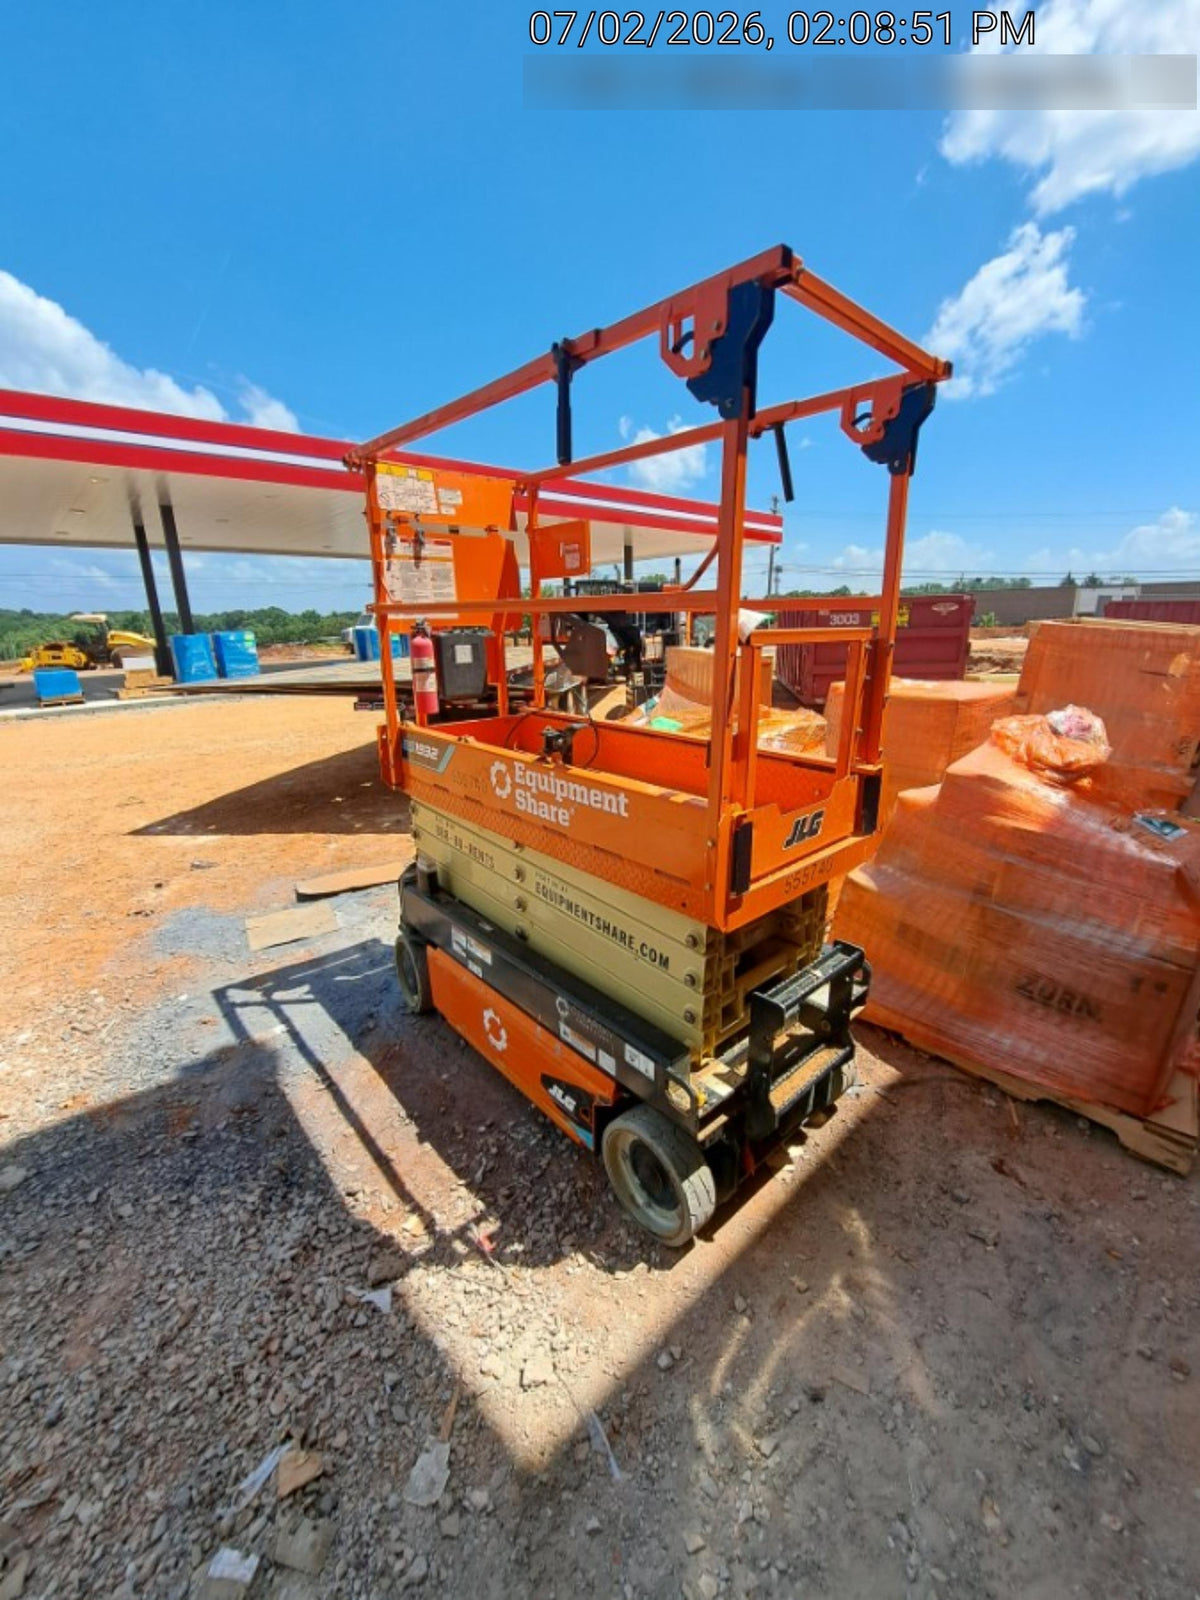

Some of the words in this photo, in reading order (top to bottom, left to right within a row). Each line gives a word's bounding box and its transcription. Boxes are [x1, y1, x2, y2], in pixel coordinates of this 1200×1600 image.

[514, 761, 629, 818] Equipment
[515, 789, 570, 827] Share
[782, 807, 826, 851] JLG
[534, 881, 670, 971] EQUIPMENTSHARE.COM
[548, 1084, 577, 1112] JLG
